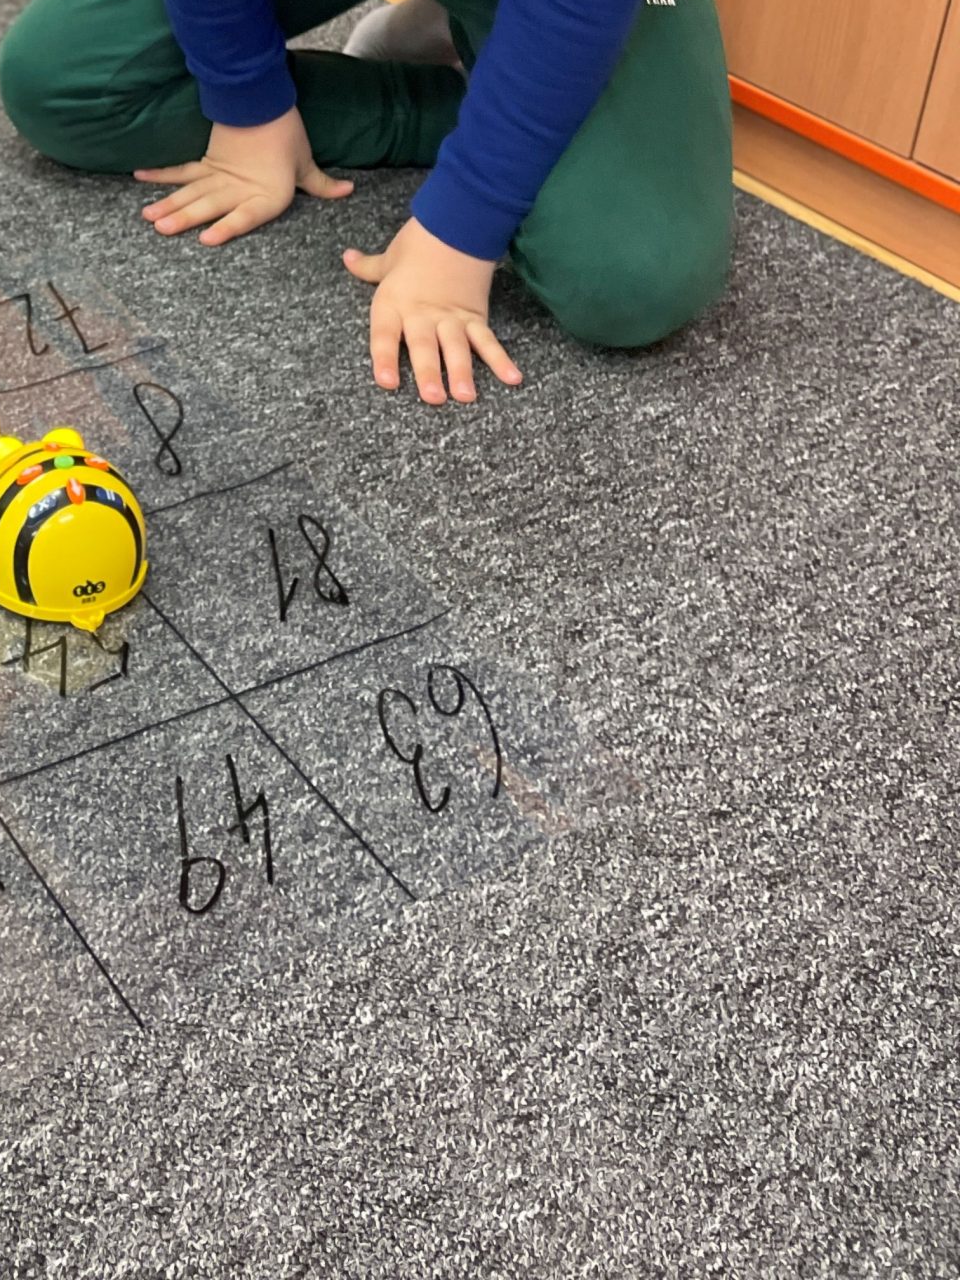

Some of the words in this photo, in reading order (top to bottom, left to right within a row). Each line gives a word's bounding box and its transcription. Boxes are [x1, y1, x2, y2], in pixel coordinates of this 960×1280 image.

[132, 381, 185, 476] 8
[269, 514, 349, 622] 81
[377, 664, 502, 814] 63
[176, 753, 274, 915] 49
